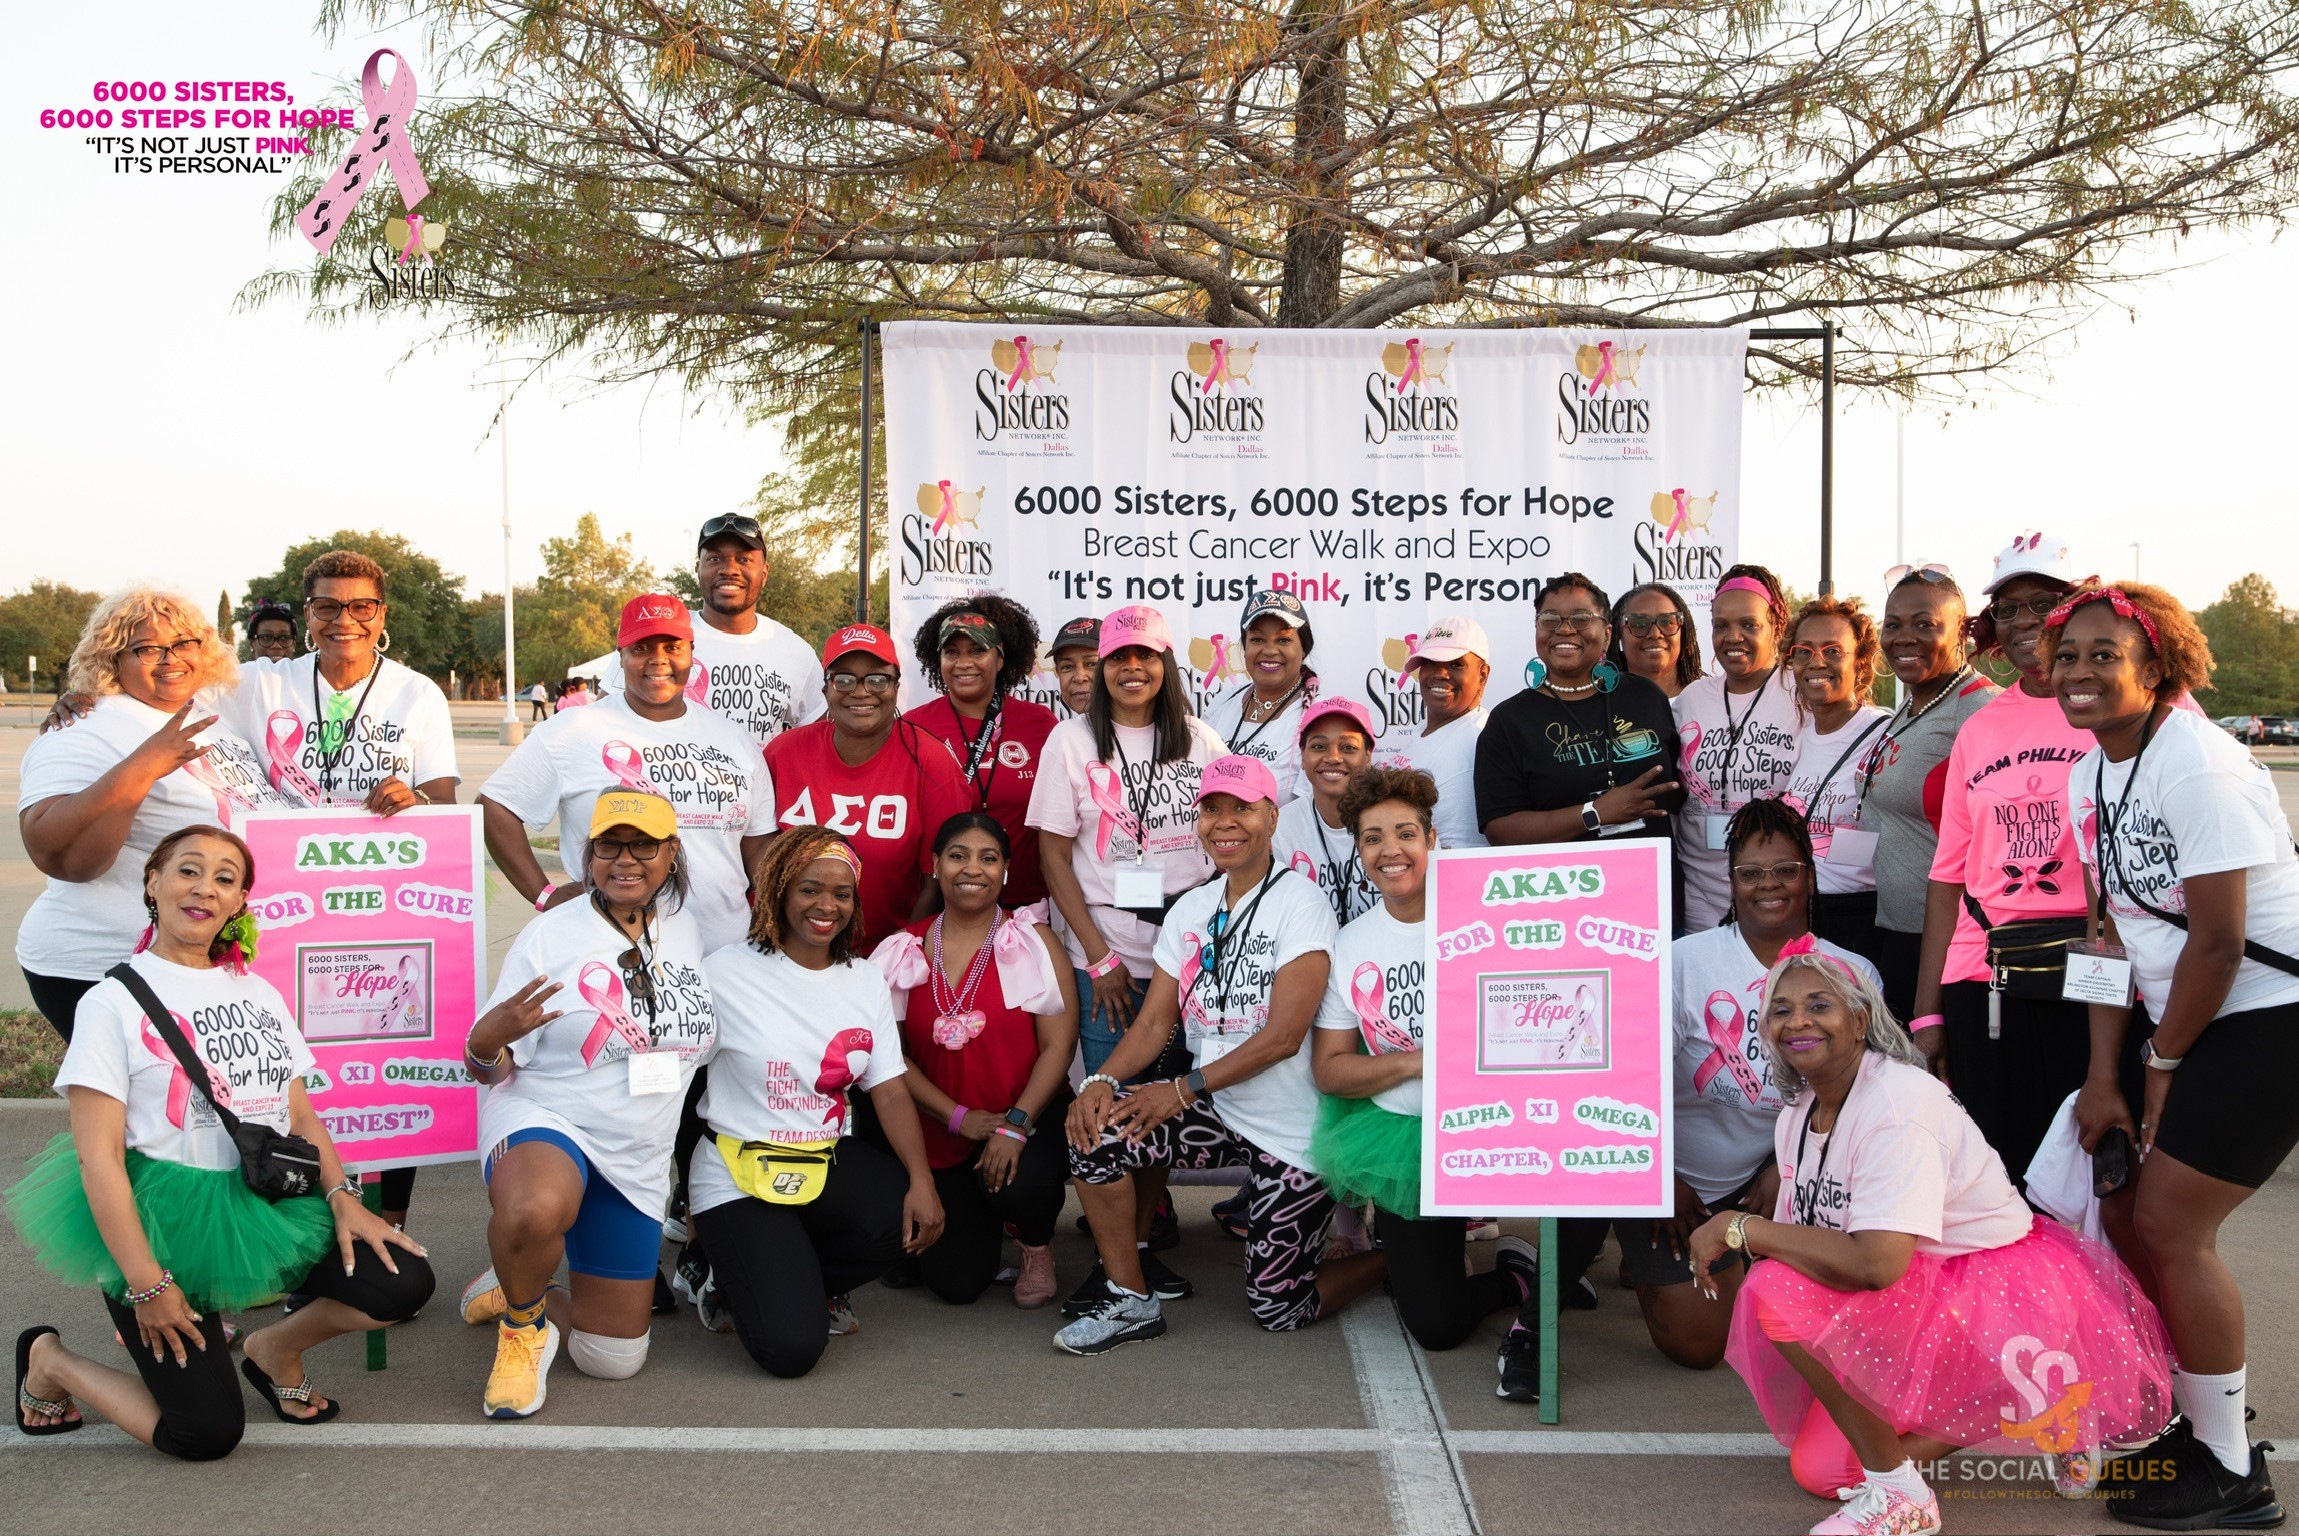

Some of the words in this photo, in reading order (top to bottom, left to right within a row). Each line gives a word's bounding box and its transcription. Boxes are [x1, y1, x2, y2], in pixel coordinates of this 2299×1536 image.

[976, 369, 1070, 441] Sisters
[1171, 371, 1265, 443] Sisters
[1366, 372, 1459, 444] Sisters
[1558, 372, 1650, 445] Sisters
[1044, 443, 1069, 451] Dallas
[1238, 445, 1263, 453] Dallas
[1014, 485, 1101, 516] 6000
[1114, 485, 1237, 522] Sisters,
[1250, 487, 1339, 517] 6000
[1351, 487, 1448, 522] Steps
[1460, 487, 1512, 517] for
[1524, 485, 1615, 523] Hope
[901, 514, 992, 586] Sisters
[1084, 527, 1178, 558] Breast
[1189, 528, 1301, 559] Cancer
[1309, 528, 1385, 559] Walk
[1394, 528, 1455, 559] and
[1469, 529, 1551, 567] Expo
[1633, 522, 1722, 588] Sisters
[1048, 569, 1112, 601] “It's
[1126, 573, 1185, 601] not
[1192, 573, 1257, 609] just
[1271, 571, 1350, 608] Pink,
[1364, 571, 1411, 602] it’s
[842, 628, 876, 641] Delta
[1116, 614, 1147, 631] Sisters
[711, 665, 751, 686] 6000
[712, 689, 753, 710] 6000
[1545, 722, 1604, 757] Share
[1701, 725, 1744, 749] 6000
[1743, 721, 1795, 751] Sisters,
[360, 742, 409, 774] Steps
[643, 743, 688, 763] 6000
[1557, 751, 1576, 763] THE
[1696, 748, 1739, 771] 6000
[1742, 746, 1792, 785] Steps
[650, 761, 697, 784] 6000
[701, 762, 748, 798] Steps
[1212, 762, 1246, 779] Sisters
[1967, 756, 2011, 790] TEAM
[669, 784, 692, 802] for
[1732, 769, 1772, 800] Hope.
[779, 785, 908, 839] ΔΣΘ
[1145, 812, 1167, 830] for
[1995, 804, 2018, 825] NO
[2028, 800, 2060, 821] ONE
[2006, 818, 2061, 843] FIGHTS
[298, 840, 419, 867] AKA’S
[1111, 836, 1135, 854] Sisters
[2007, 839, 2056, 859] ALONE
[1485, 868, 1600, 902] AKA’S
[251, 897, 307, 922] FOR
[325, 890, 383, 910] THE
[398, 889, 473, 917] CURE
[1435, 926, 1492, 960] FOR
[1505, 923, 1562, 945] THE
[1579, 921, 1657, 953] CURE
[308, 966, 332, 974] 6000
[363, 964, 380, 972] FOR
[334, 954, 371, 962] SISTERS,
[335, 966, 400, 998] Hope
[1489, 984, 1510, 992] 6000
[1513, 983, 1548, 991] SISTERS,
[1489, 995, 1510, 1003] 6000
[1513, 994, 1538, 1002] STEPS
[193, 1003, 245, 1036] 6000
[404, 1014, 424, 1028] Sisters
[1513, 996, 1576, 1029] Hope
[206, 1032, 259, 1064] 6000
[603, 1041, 632, 1061] Sisters
[1580, 1045, 1601, 1059] Sisters
[228, 1062, 252, 1088] for
[347, 1064, 370, 1081] XI
[384, 1063, 476, 1083] OMEGA’S
[766, 1061, 791, 1077] THE
[766, 1079, 800, 1095] FIGHT
[1711, 1077, 1741, 1098] Sisters
[242, 1105, 253, 1113] AND
[768, 1095, 832, 1111] CONTINUES
[1442, 1104, 1511, 1130] ALPHA
[1529, 1102, 1554, 1118] XI
[1577, 1104, 1653, 1131] OMEGA
[770, 1130, 803, 1143] TEAM
[1444, 1151, 1548, 1169] CHAPTER,
[1564, 1149, 1650, 1167] DALLAS
